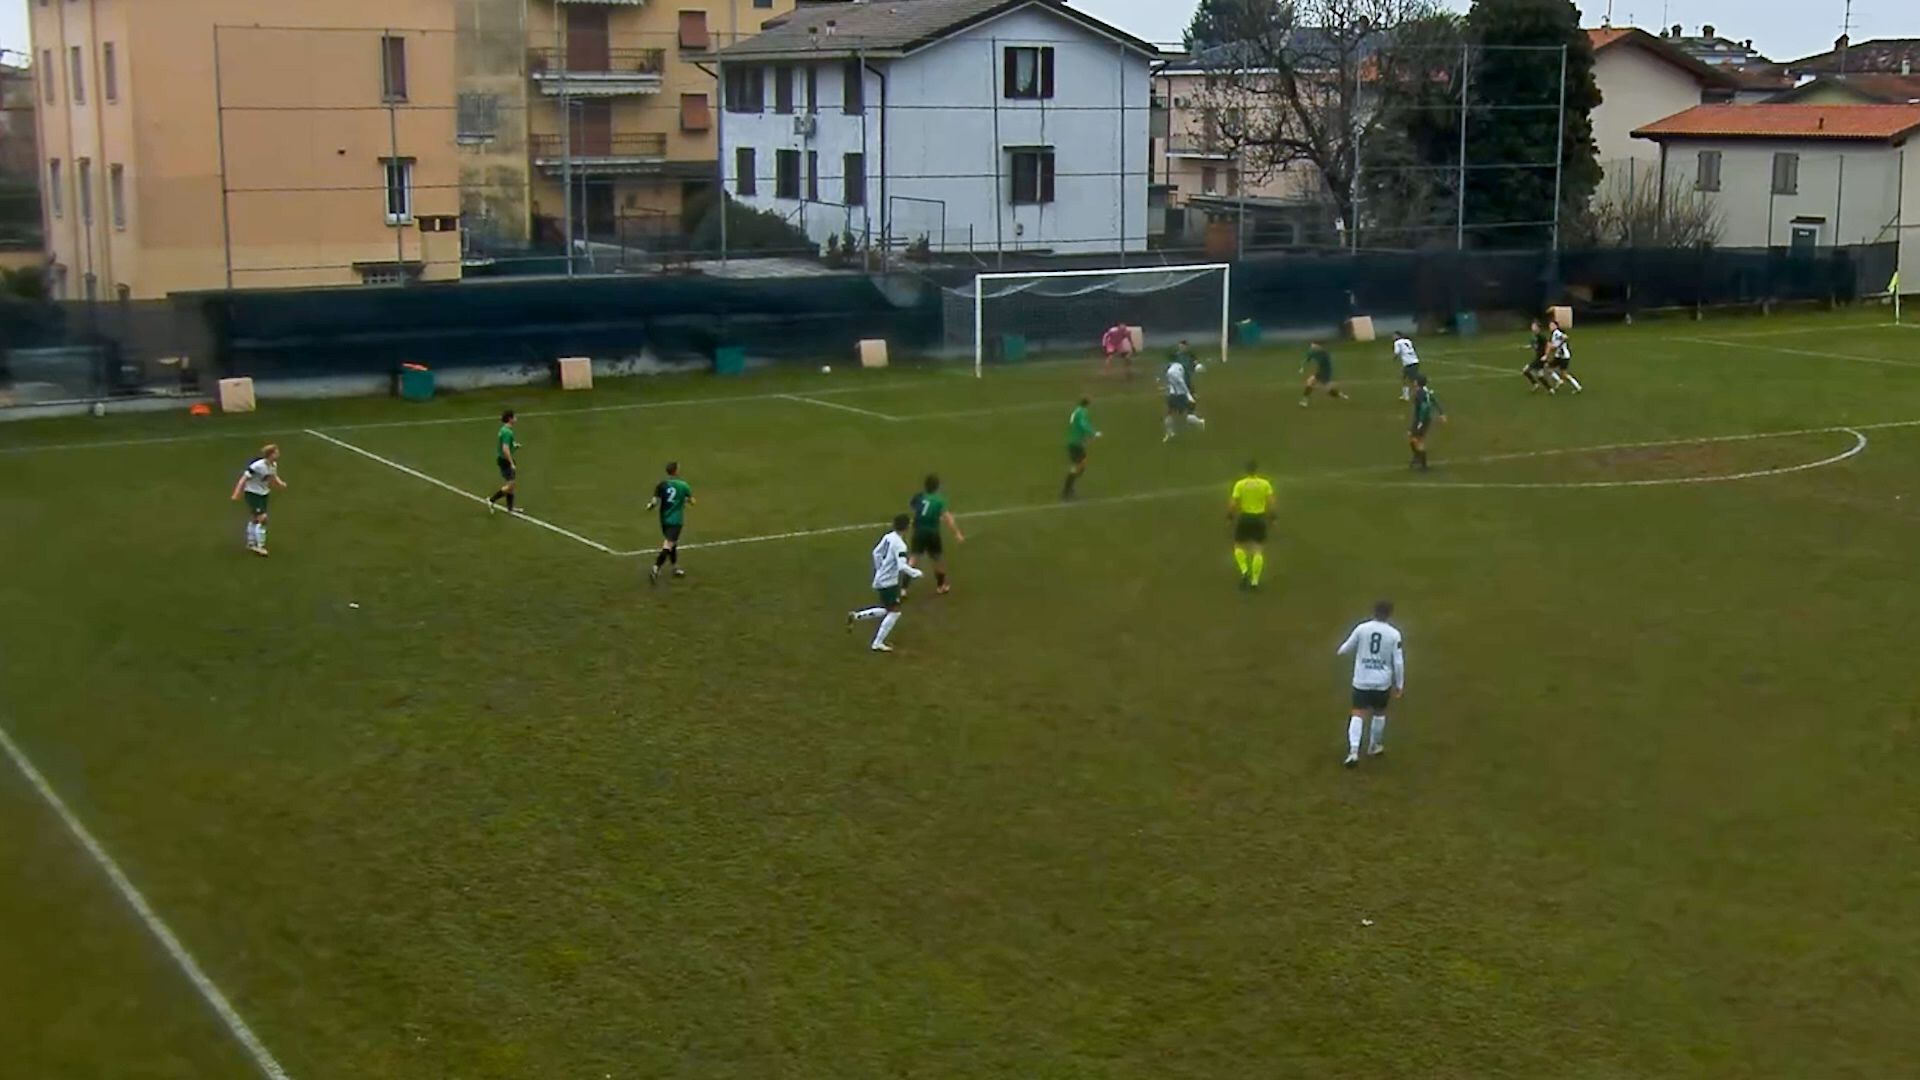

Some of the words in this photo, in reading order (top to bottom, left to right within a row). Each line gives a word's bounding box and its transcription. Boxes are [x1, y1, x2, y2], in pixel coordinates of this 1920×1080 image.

[666, 486, 677, 503] 2
[921, 499, 931, 516] 7
[1370, 632, 1382, 655] 8
